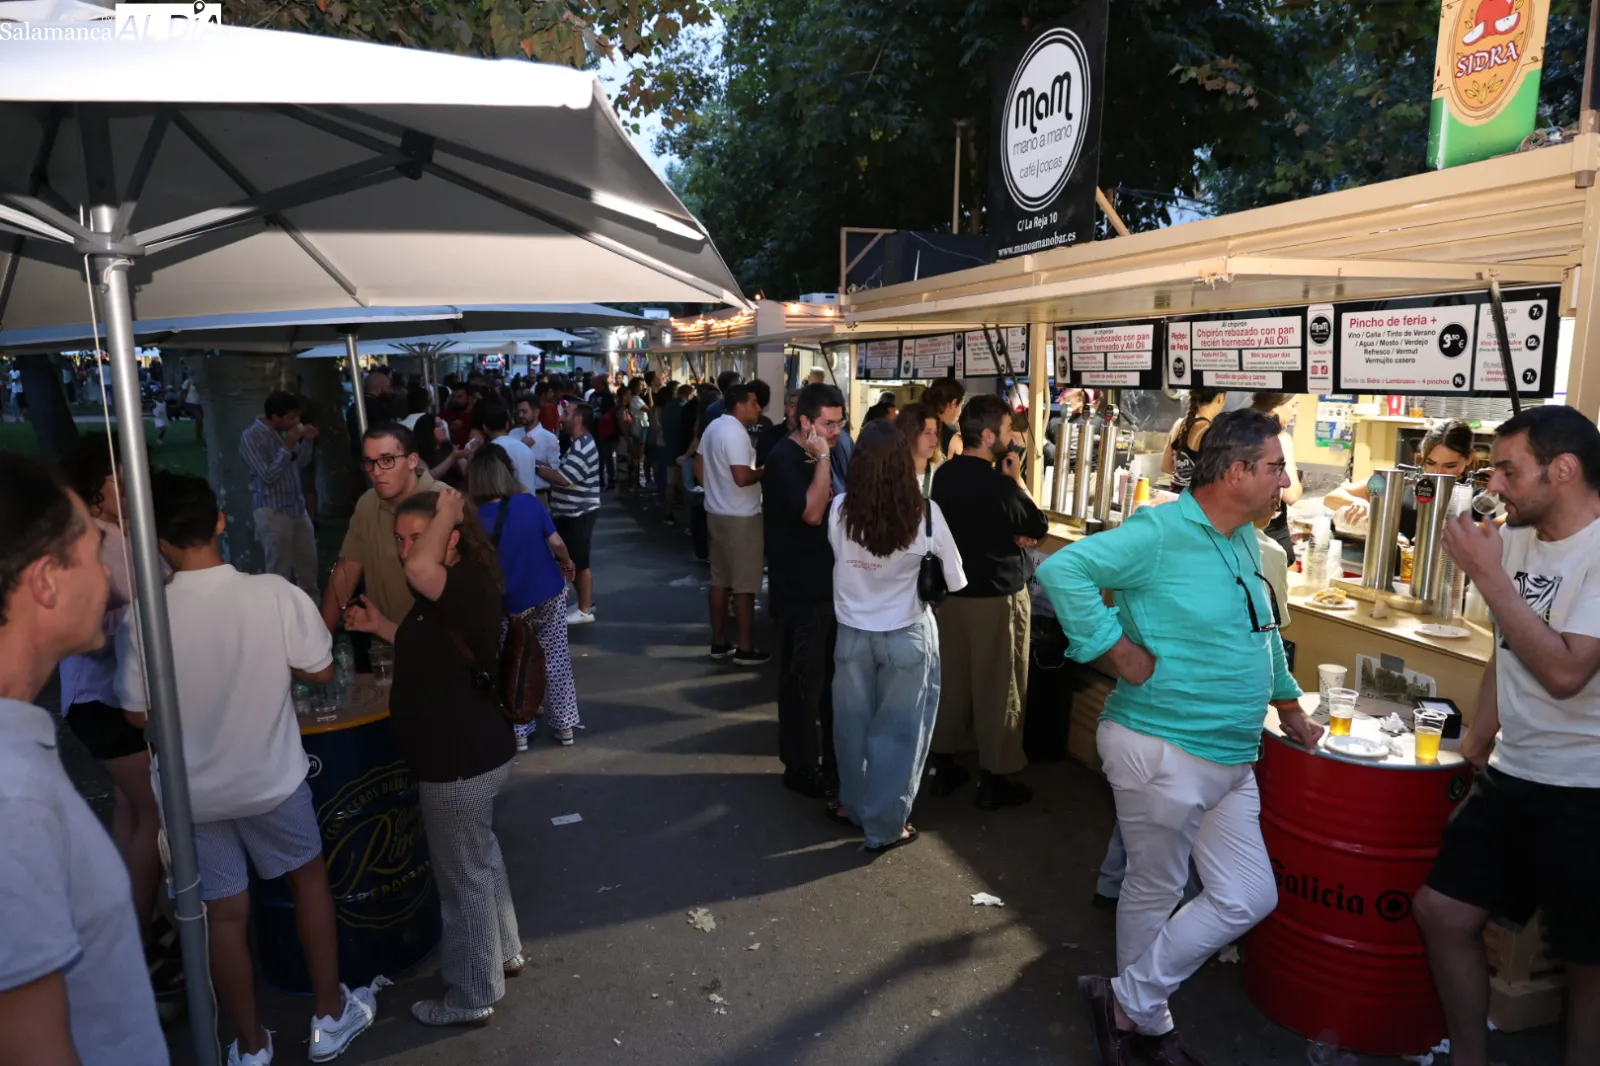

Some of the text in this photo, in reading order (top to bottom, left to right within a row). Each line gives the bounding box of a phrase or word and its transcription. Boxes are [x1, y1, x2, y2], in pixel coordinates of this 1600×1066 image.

[1455, 41, 1520, 78] SIDRA
[1013, 124, 1072, 156] mano a mano
[1017, 211, 1058, 232] C/ La Reja 10
[998, 230, 1076, 256] www.manoamanobar.es
[1349, 317, 1384, 328] Pincho
[1387, 316, 1400, 326] de
[1403, 315, 1428, 326] feria
[1096, 334, 1121, 342] rebozado
[1137, 333, 1150, 342] pan
[1197, 326, 1294, 338] Chipirón rebozado con pan
[1201, 336, 1288, 348] recién horneado y Ali Oli
